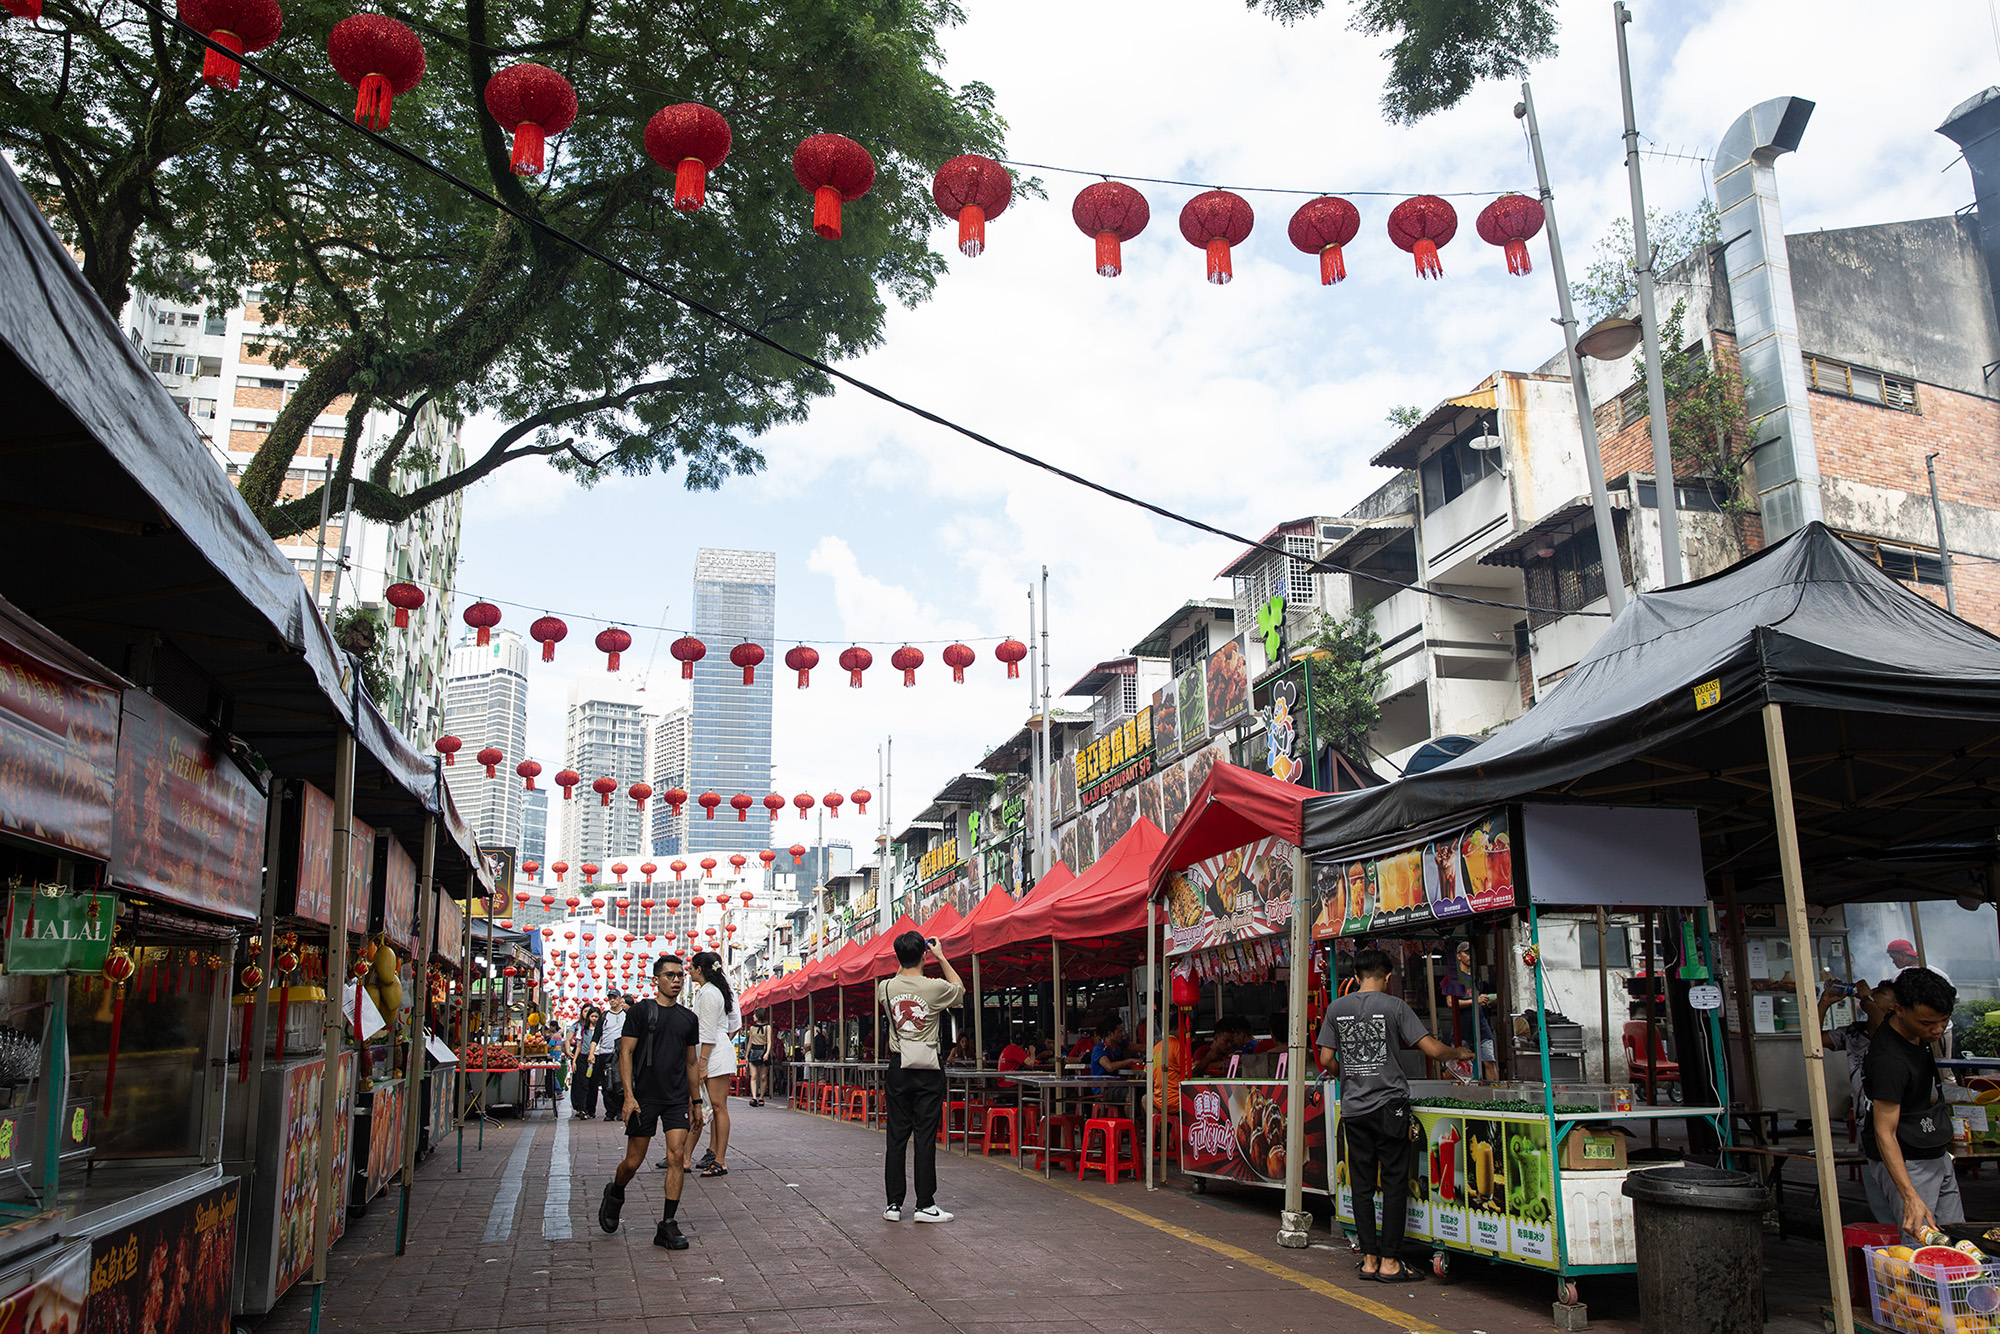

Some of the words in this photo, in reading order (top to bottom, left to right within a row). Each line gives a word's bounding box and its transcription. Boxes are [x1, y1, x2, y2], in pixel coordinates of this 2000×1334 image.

[709, 555, 765, 568] PAVILION
[1100, 762, 1138, 798] RESTAURANT
[20, 918, 107, 941] HALAL
[1807, 917, 1834, 925] TAY
[890, 993, 912, 1006] MOUNT
[1189, 1119, 1236, 1160] Takoyaki
[194, 1198, 219, 1235] Sizzling
